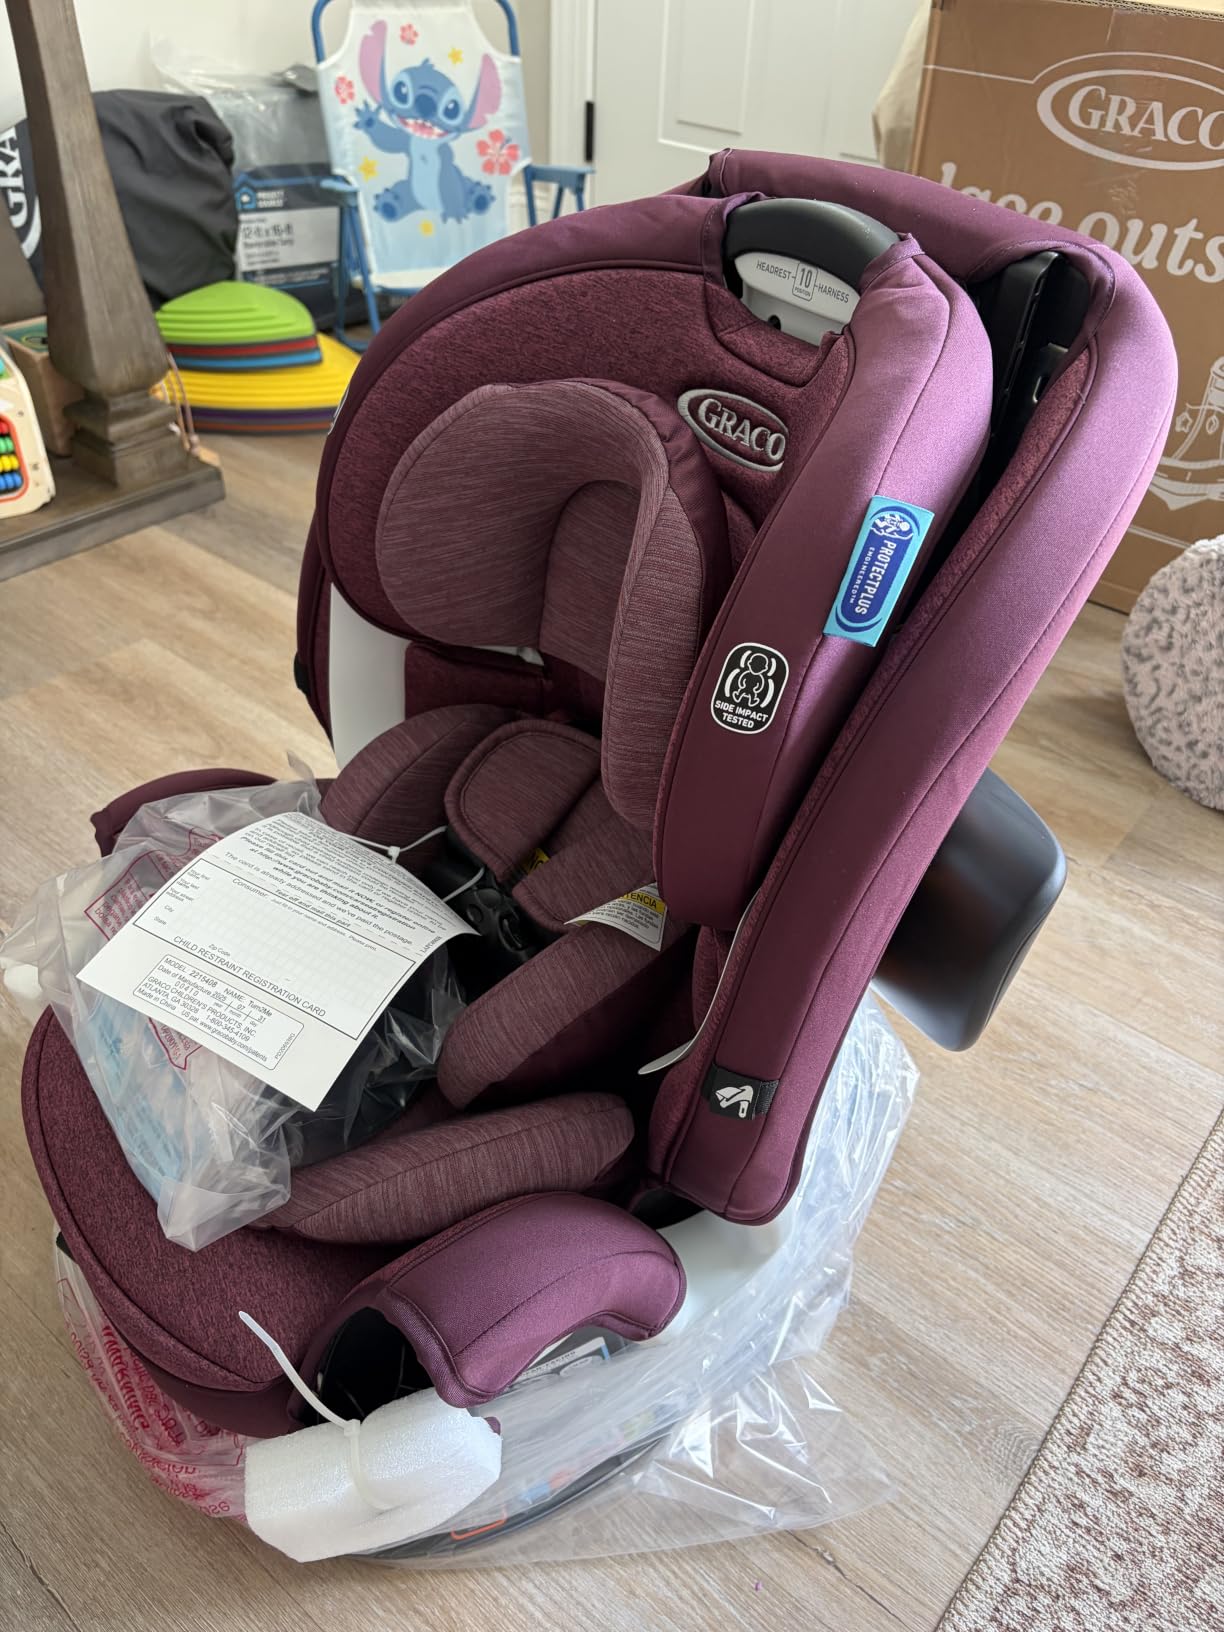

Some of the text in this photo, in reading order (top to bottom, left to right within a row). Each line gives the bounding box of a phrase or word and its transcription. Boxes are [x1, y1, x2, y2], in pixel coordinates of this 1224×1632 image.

[756, 260, 792, 281] HEADREST
[799, 267, 813, 289] 10
[794, 286, 812, 298] POSITION
[818, 282, 850, 304] HARNESS
[698, 398, 786, 461] GRACO
[855, 540, 897, 615] PROTECTPLUS
[715, 700, 768, 723] SIDE IMPACT
[722, 712, 755, 729] TESTED
[275, 889, 289, 898] Tear
[309, 906, 326, 915] mail
[323, 913, 337, 921] this
[336, 919, 351, 928] part
[157, 964, 172, 975] Date
[177, 974, 212, 996] Manufacture
[212, 991, 227, 1002] 2025
[236, 1003, 246, 1011] 07
[256, 1015, 267, 1023] 31
[173, 935, 326, 1017] CHILD RESTRAINT REGISTRATION CARD
[189, 970, 218, 988] 2215408
[137, 987, 154, 999] Made
[159, 998, 177, 1011] China
[181, 1009, 191, 1018] US
[199, 1021, 267, 1062] www.gracobaby.com/patents
[147, 976, 171, 991] GRACO
[170, 987, 208, 1010] CHILDREN'S
[243, 1026, 257, 1037] INC.
[170, 996, 181, 1005] GA
[180, 1000, 200, 1014] 30328
[206, 1014, 250, 1042] 1-800-345-4109
